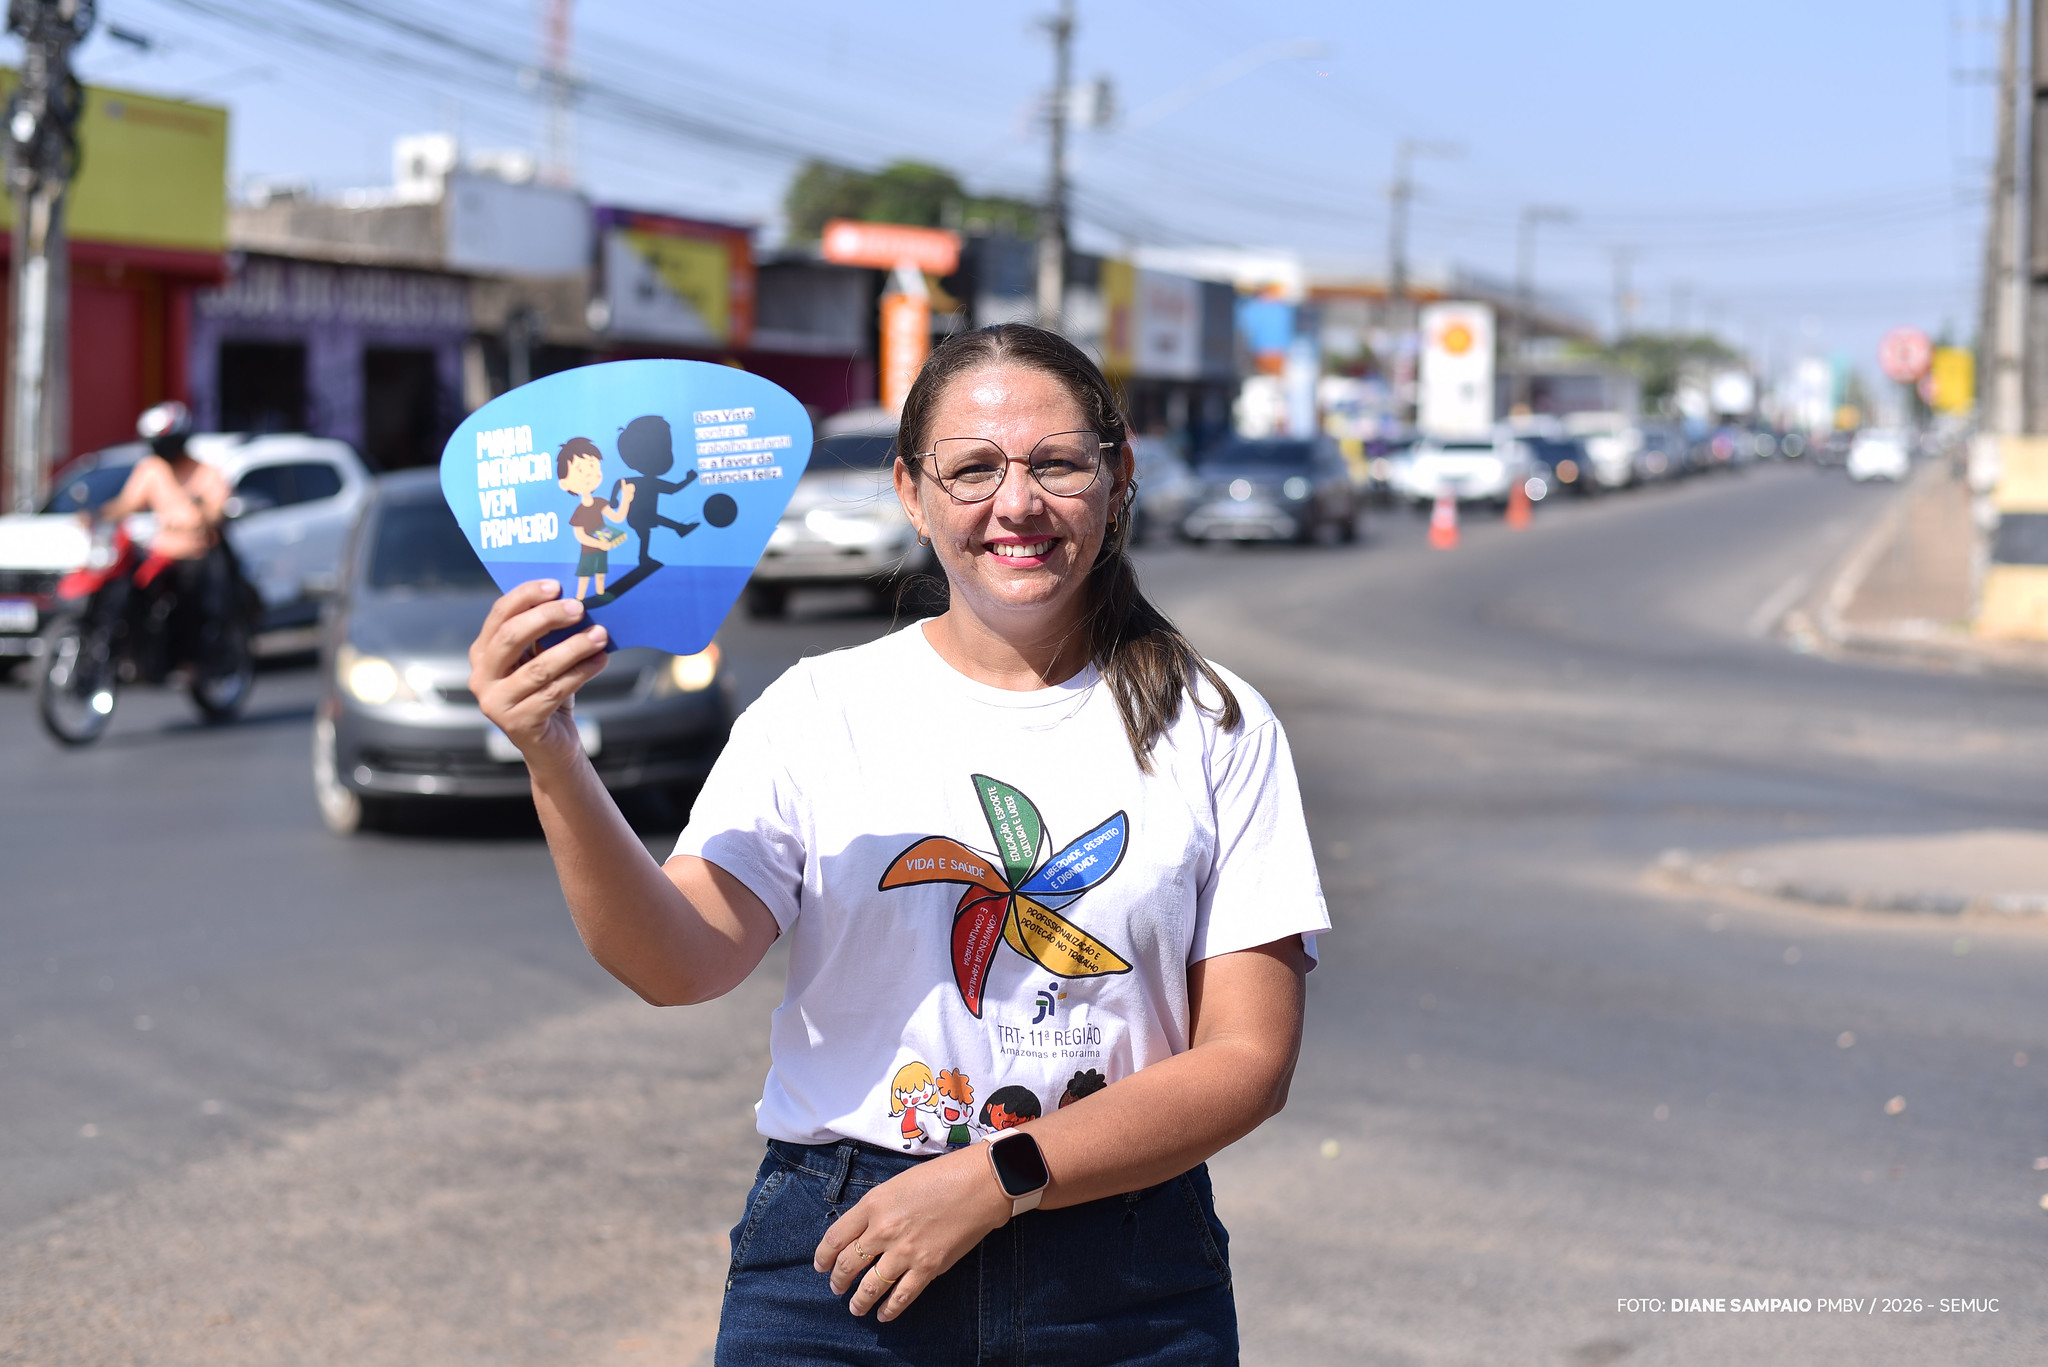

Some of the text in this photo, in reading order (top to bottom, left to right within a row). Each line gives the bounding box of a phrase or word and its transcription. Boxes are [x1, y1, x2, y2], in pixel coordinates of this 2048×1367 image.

[696, 410, 754, 423] Boa Vista
[696, 426, 735, 438] contra
[477, 425, 533, 460] MINHA
[697, 437, 791, 453] trabalho infantil
[477, 452, 552, 489] INFÂNCIA
[711, 460, 717, 468] a
[721, 457, 752, 467] favor
[757, 454, 772, 464] da
[701, 473, 748, 484] infância
[478, 487, 518, 519] VEM
[480, 511, 559, 550] PRIMEIRO
[987, 785, 1006, 821] ESPORTE
[1003, 794, 1020, 819] LAZER
[1014, 824, 1033, 858] CULTURA
[1082, 827, 1119, 852] RESPEITO
[906, 857, 985, 880] VIDA E SAÚDE
[1050, 854, 1099, 890] E DIGNIDADE
[963, 906, 989, 967] E COMUNITÁRIA
[1020, 917, 1099, 973] PROTEÇÃO NO TRABALHO
[1026, 906, 1101, 961] PROFISSIONALIZAÇÃO E
[967, 914, 998, 999] CONVIVÊNCIA FAMILIAR
[1029, 1029, 1050, 1047] 11ª
[1054, 1022, 1102, 1047] REGIÃO
[1000, 1046, 1049, 1059] Amazonas
[1061, 1049, 1101, 1058] Roraima
